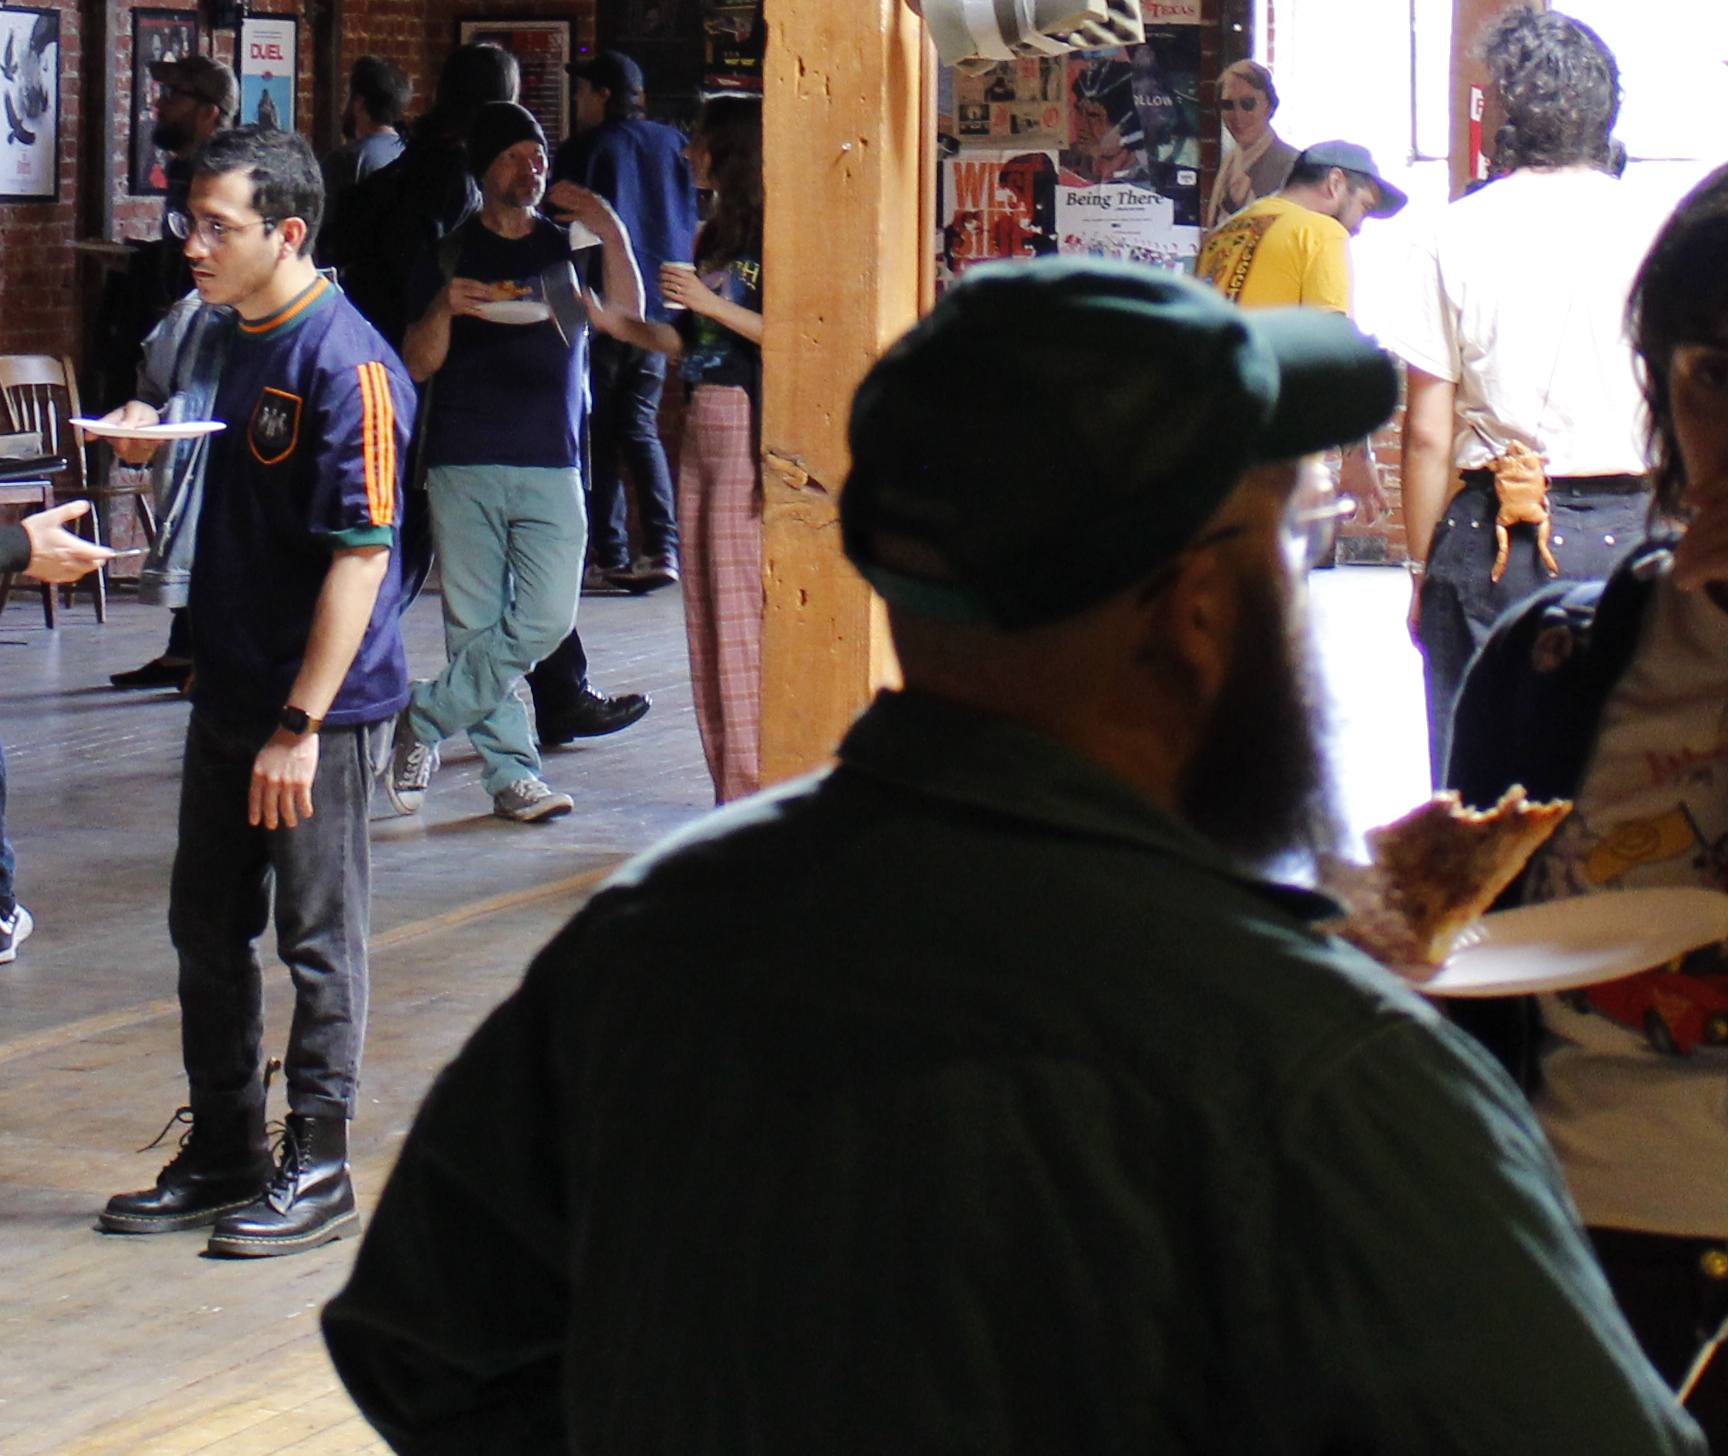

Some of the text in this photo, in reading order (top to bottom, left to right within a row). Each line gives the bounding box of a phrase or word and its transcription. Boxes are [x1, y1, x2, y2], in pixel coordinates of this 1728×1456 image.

[250, 43, 284, 60] DUEL
[1066, 190, 1164, 210] Being There
